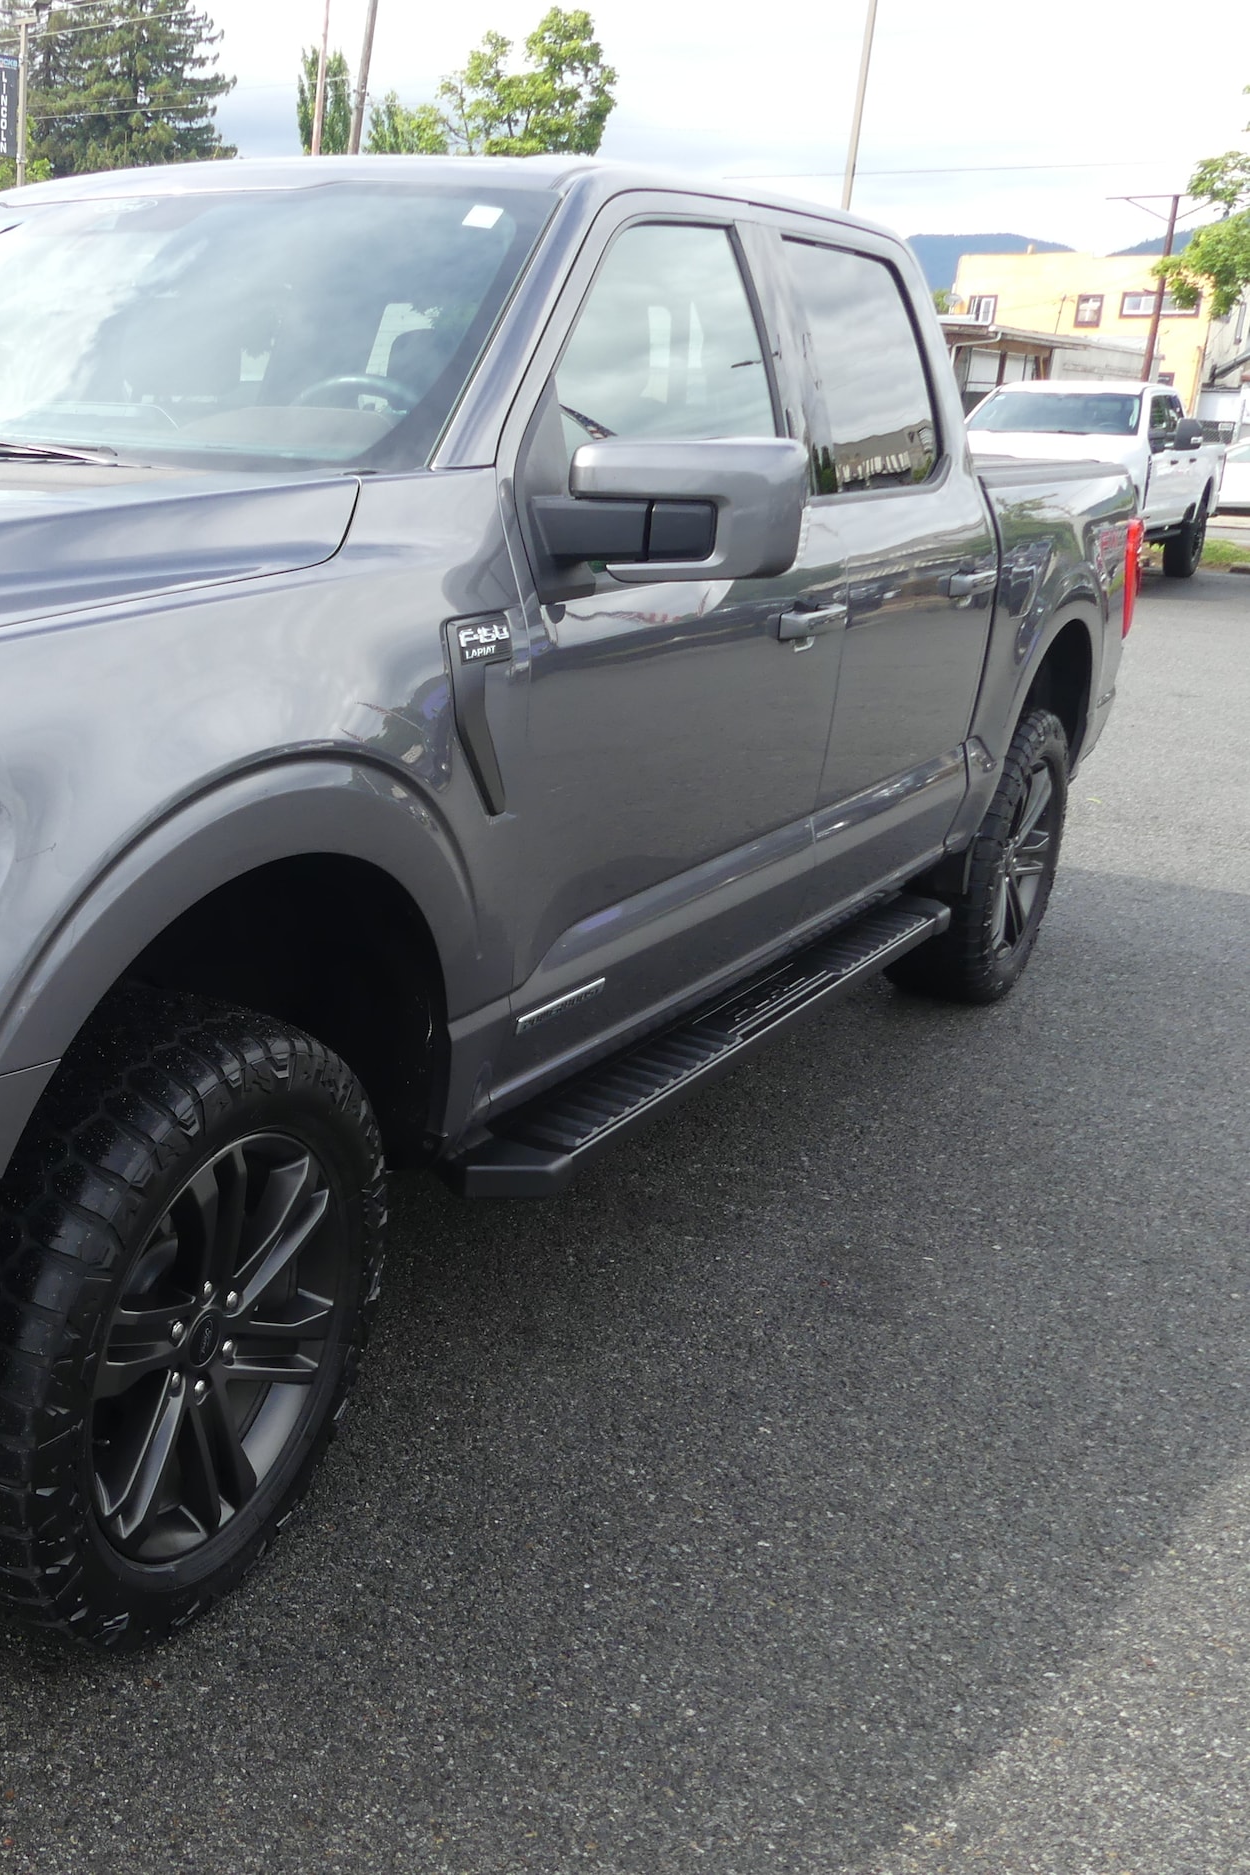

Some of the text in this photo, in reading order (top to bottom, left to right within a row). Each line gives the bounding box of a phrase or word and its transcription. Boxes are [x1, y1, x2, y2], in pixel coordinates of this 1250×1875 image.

[0, 71, 8, 153] LINCOLN
[458, 624, 510, 648] F-150
[465, 645, 496, 660] LARIAT
